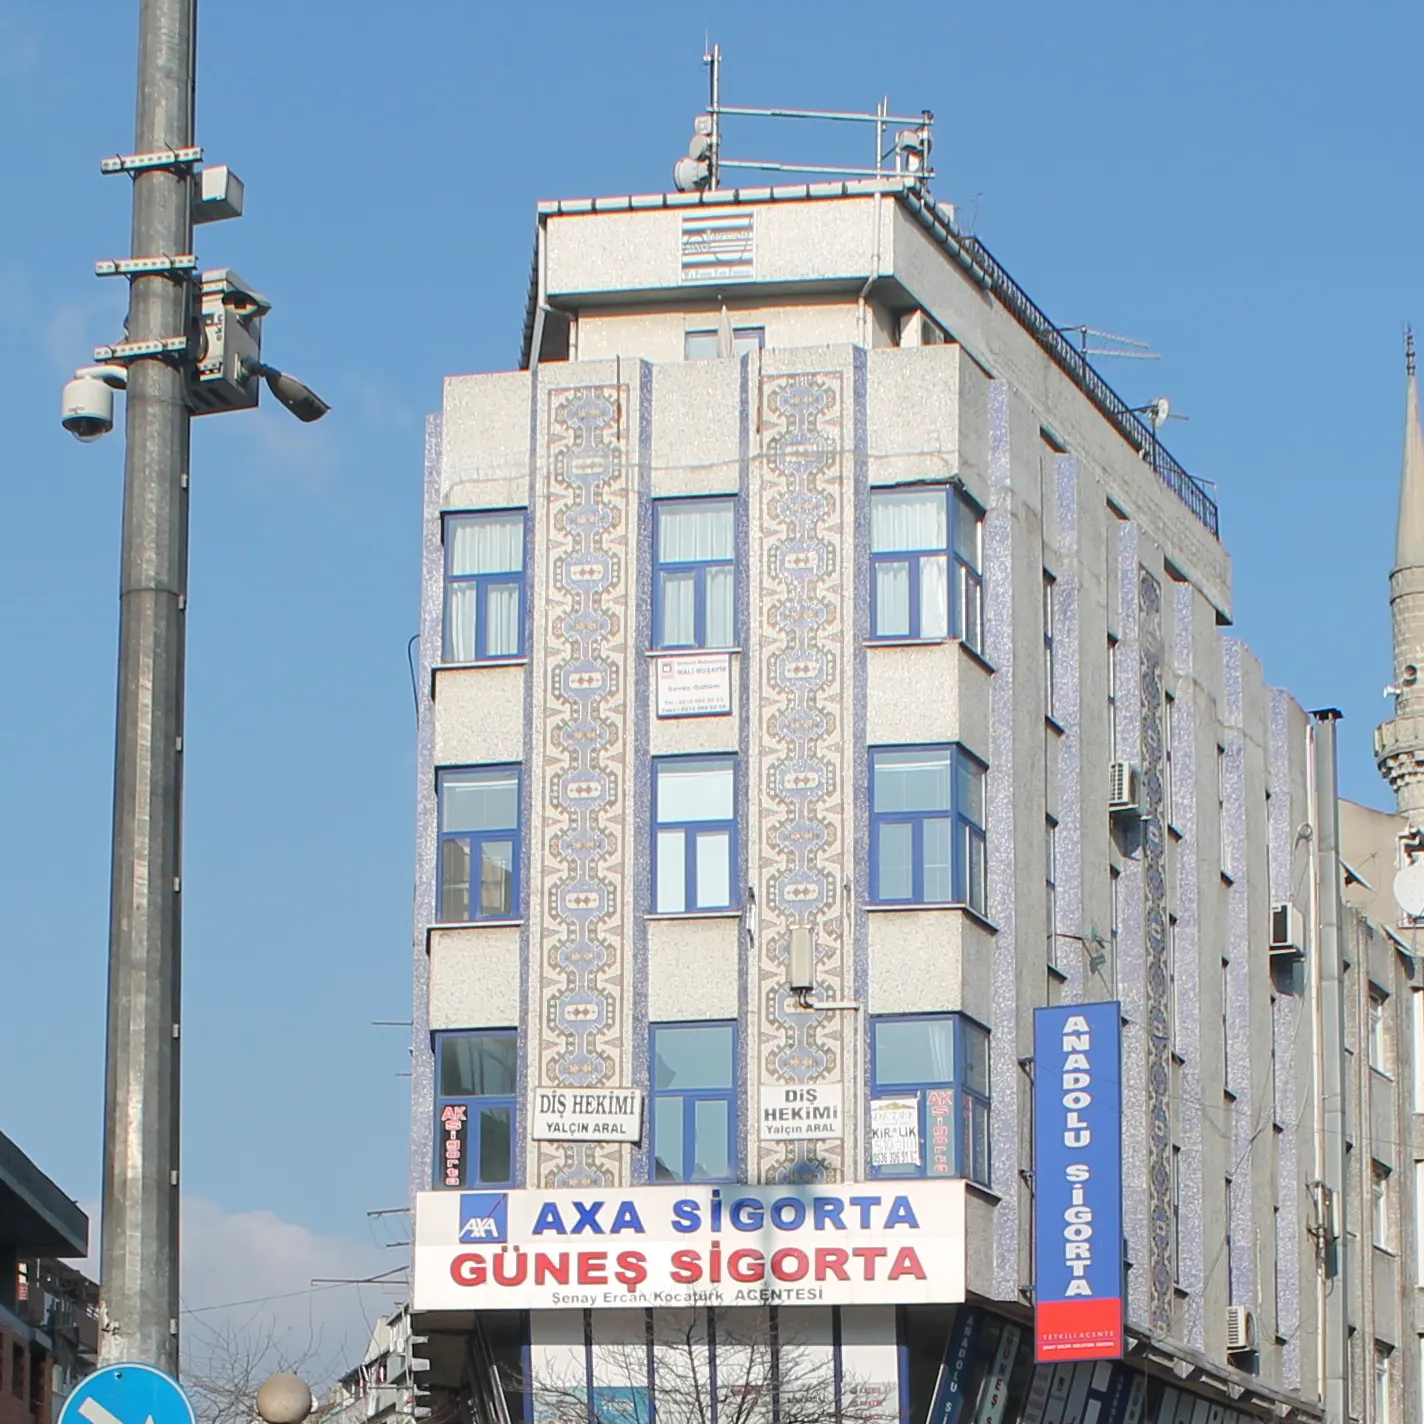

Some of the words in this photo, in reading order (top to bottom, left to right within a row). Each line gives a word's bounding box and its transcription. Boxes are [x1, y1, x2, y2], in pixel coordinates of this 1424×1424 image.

[1062, 1015, 1092, 1148] ANADOLU
[539, 1090, 566, 1119] DİŞ
[574, 1090, 636, 1115] HEKİMİ
[784, 1088, 818, 1106] DİŞ
[927, 1091, 952, 1105] AK
[441, 1105, 467, 1121] AK
[763, 1106, 838, 1121] HEKİMİ
[546, 1121, 589, 1136] YALÇIN
[592, 1122, 626, 1134] ARAL
[765, 1124, 802, 1136] Yalçın
[805, 1123, 836, 1133] ARAL
[531, 1200, 646, 1236] AXA
[671, 1189, 921, 1234] SİGORTA
[459, 1217, 500, 1238] AXA
[1064, 1164, 1093, 1297] SİGORTA
[449, 1245, 648, 1293] GÜNEŞ
[669, 1240, 928, 1285] SİGORTA
[552, 1291, 597, 1306] Şenay
[603, 1292, 647, 1304] Ercan
[653, 1290, 724, 1303] Kocatürk
[1079, 1330, 1114, 1339] ACENTE
[950, 1315, 975, 1393] ANADOLU
